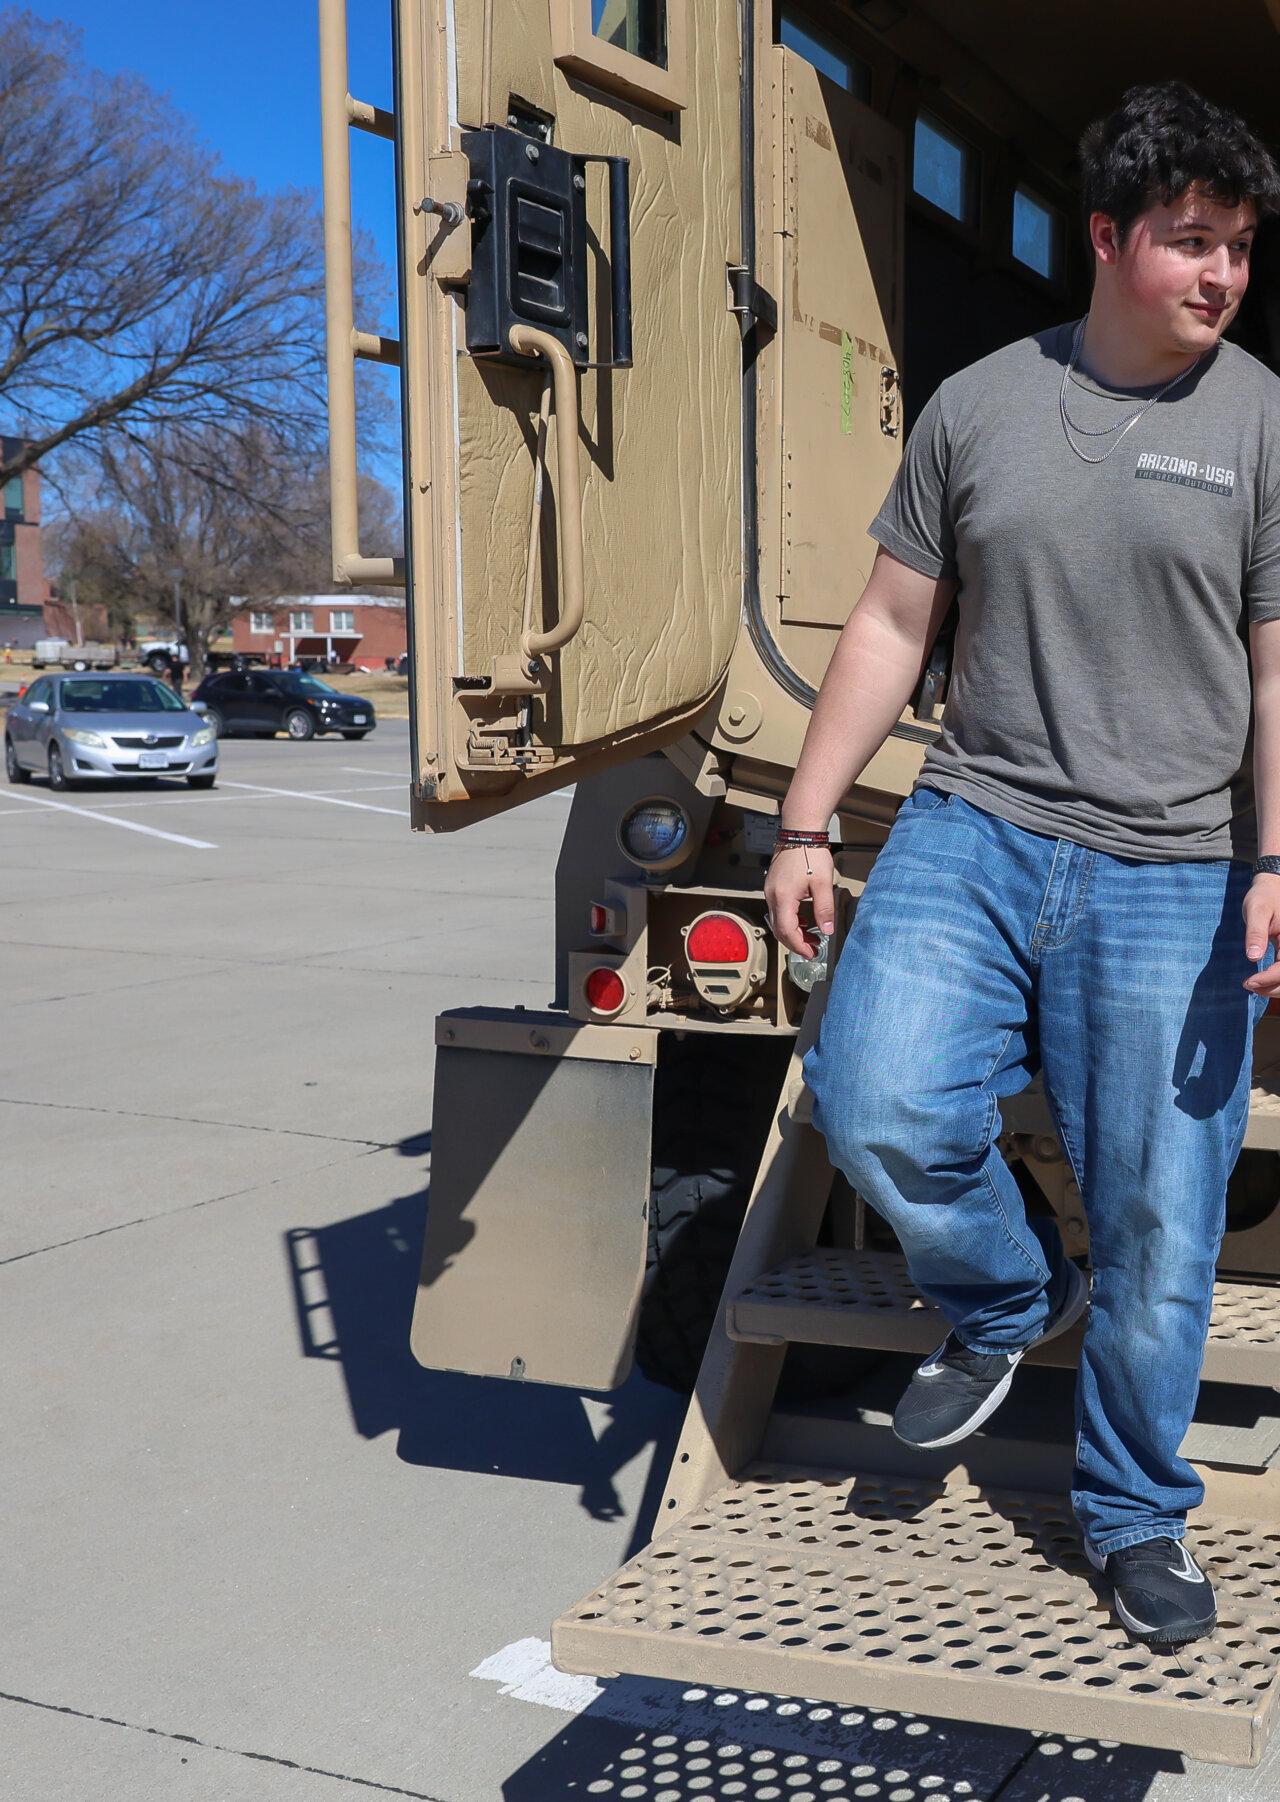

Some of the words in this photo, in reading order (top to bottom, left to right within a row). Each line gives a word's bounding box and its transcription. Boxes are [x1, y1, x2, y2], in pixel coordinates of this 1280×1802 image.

[1138, 470, 1154, 479] THE
[1156, 472, 1182, 483] GREAT
[1184, 479, 1229, 495] OUTDOORS
